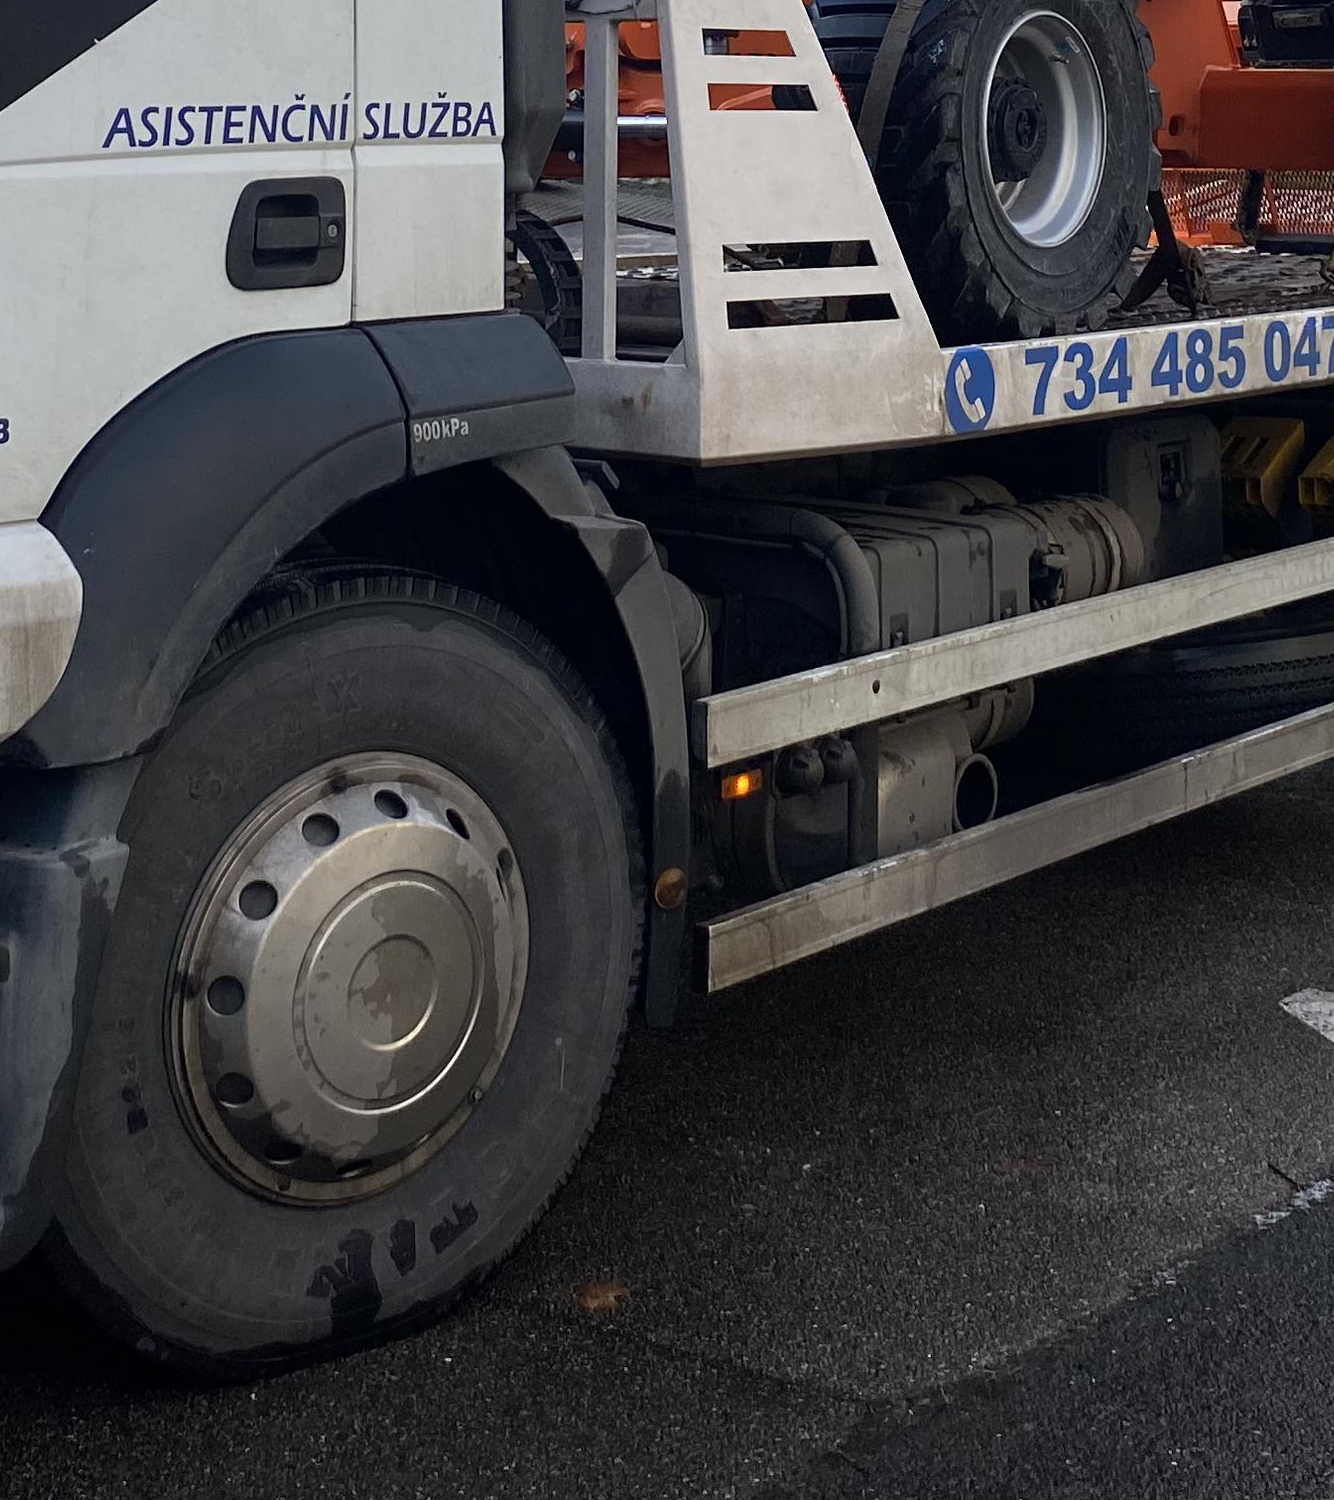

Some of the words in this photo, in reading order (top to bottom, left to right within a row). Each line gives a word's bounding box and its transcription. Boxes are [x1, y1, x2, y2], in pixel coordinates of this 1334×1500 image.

[102, 92, 351, 148] ASISTENČNÍ
[362, 91, 497, 140] SLUŽBA
[1024, 336, 1132, 416] 734
[1151, 325, 1247, 397] 485
[413, 417, 469, 443] 900kPa
